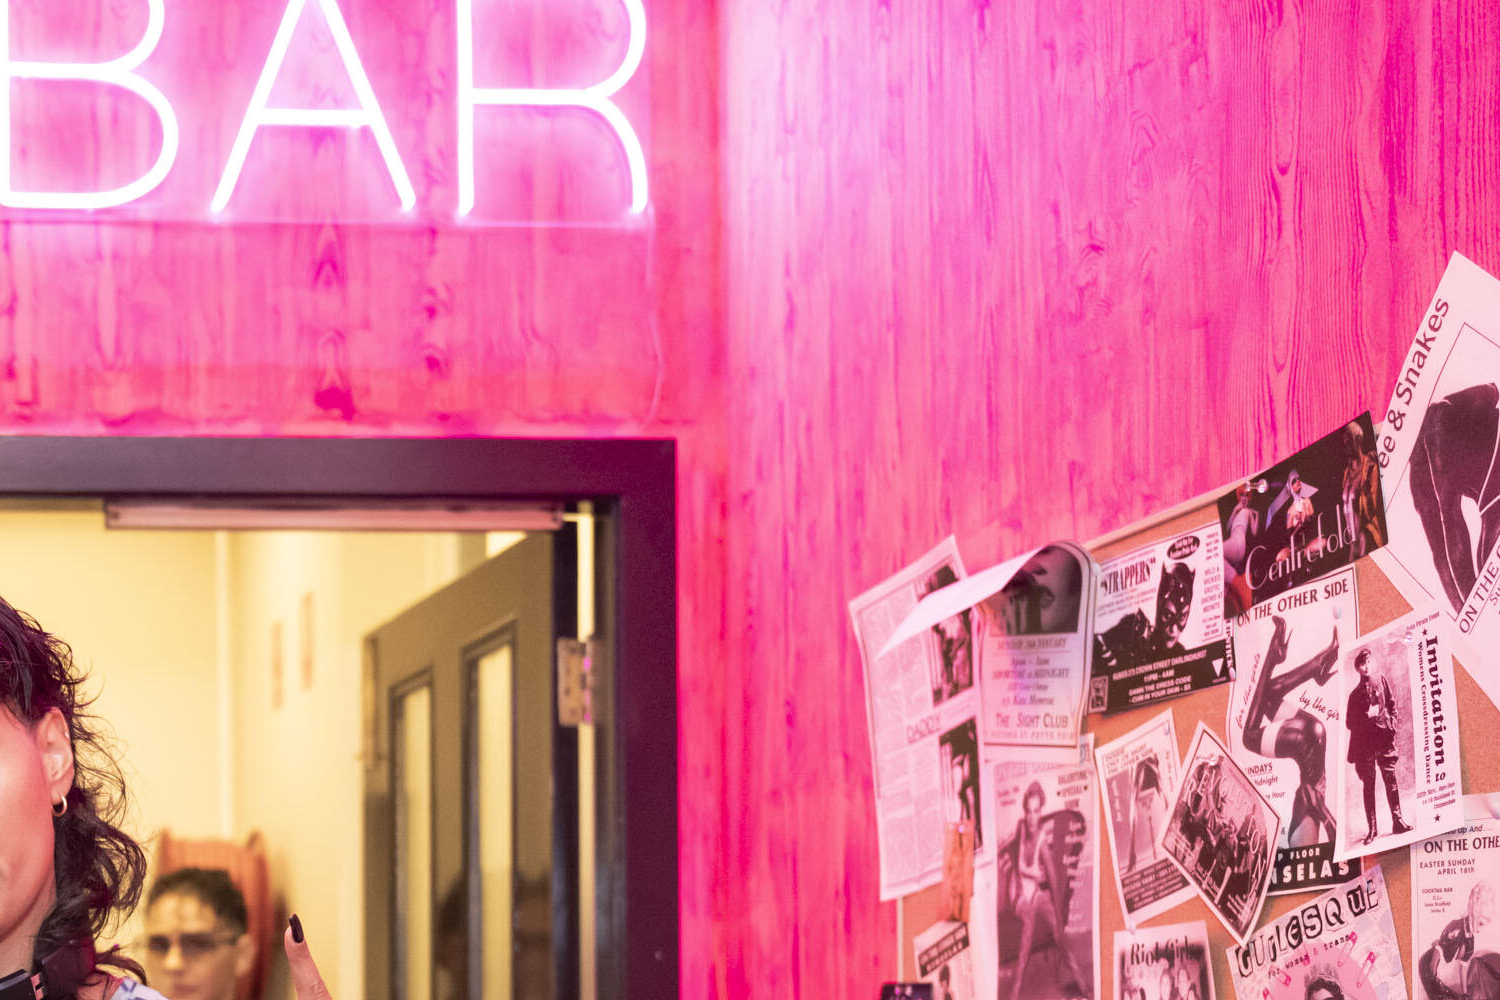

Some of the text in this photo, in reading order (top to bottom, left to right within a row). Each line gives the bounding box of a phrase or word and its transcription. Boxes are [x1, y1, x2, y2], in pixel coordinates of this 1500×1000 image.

[1396, 298, 1450, 406] Snakes
[1387, 409, 1406, 432] &
[1245, 504, 1357, 590] Centrefold
[1237, 608, 1251, 627] ON
[1254, 601, 1272, 620] THE
[1277, 588, 1318, 612] OTHER
[1323, 577, 1349, 600] SIDE
[1459, 562, 1499, 634] ON THE
[1417, 642, 1425, 682] Womens
[1312, 697, 1326, 714] the
[1426, 635, 1447, 766] Invitation
[996, 712, 1010, 728] THE
[1043, 712, 1069, 729] CLUB
[1420, 684, 1431, 752] Crossdressing
[1435, 772, 1446, 782] to
[1290, 846, 1321, 860] FLOOR
[1424, 835, 1500, 853] ON THE OTHE
[1420, 858, 1476, 869] EASTER SUNDAY
[1437, 868, 1457, 876] APRIL
[1285, 954, 1309, 969] women
